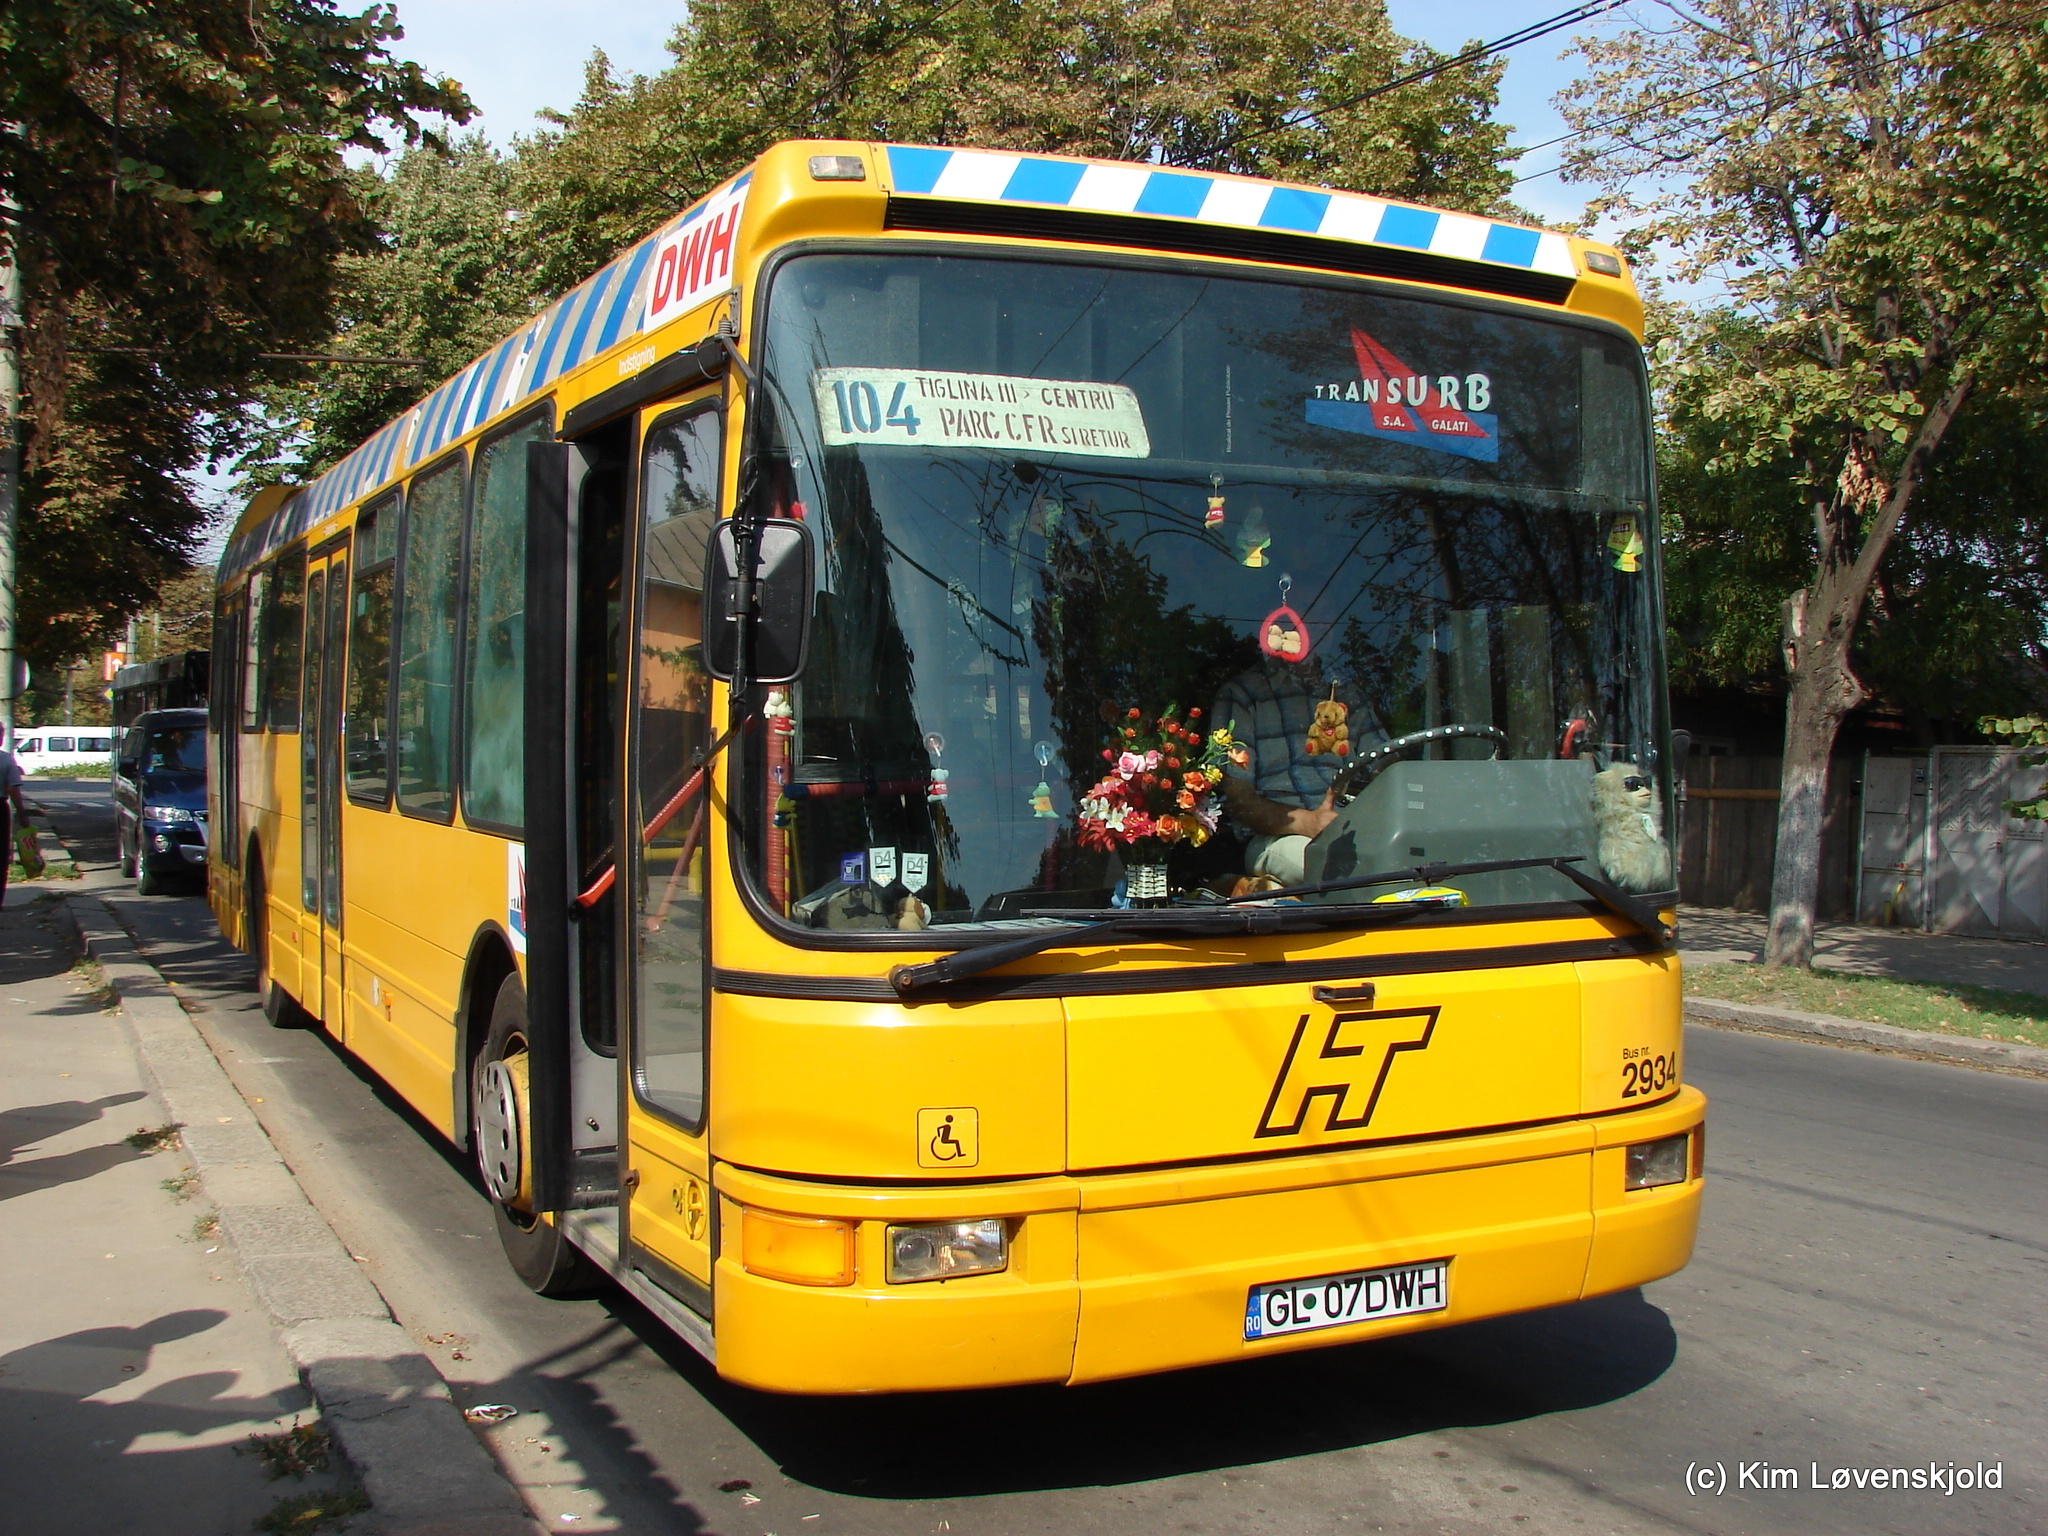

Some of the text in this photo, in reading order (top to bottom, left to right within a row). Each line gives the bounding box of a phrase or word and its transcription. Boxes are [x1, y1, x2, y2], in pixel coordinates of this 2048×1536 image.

[651, 202, 740, 316] DWH
[832, 380, 921, 436] 104
[915, 376, 1115, 410] TIGLINA III CENTRU
[1314, 372, 1490, 412] TRANSURB
[939, 408, 1000, 440] PARC
[1382, 415, 1468, 432] S.A. GALATI
[1623, 1046, 1651, 1060] Bus nr.
[1621, 1051, 1676, 1099] 2934
[1246, 1315, 1261, 1332] RO
[1266, 1286, 1311, 1327] GL
